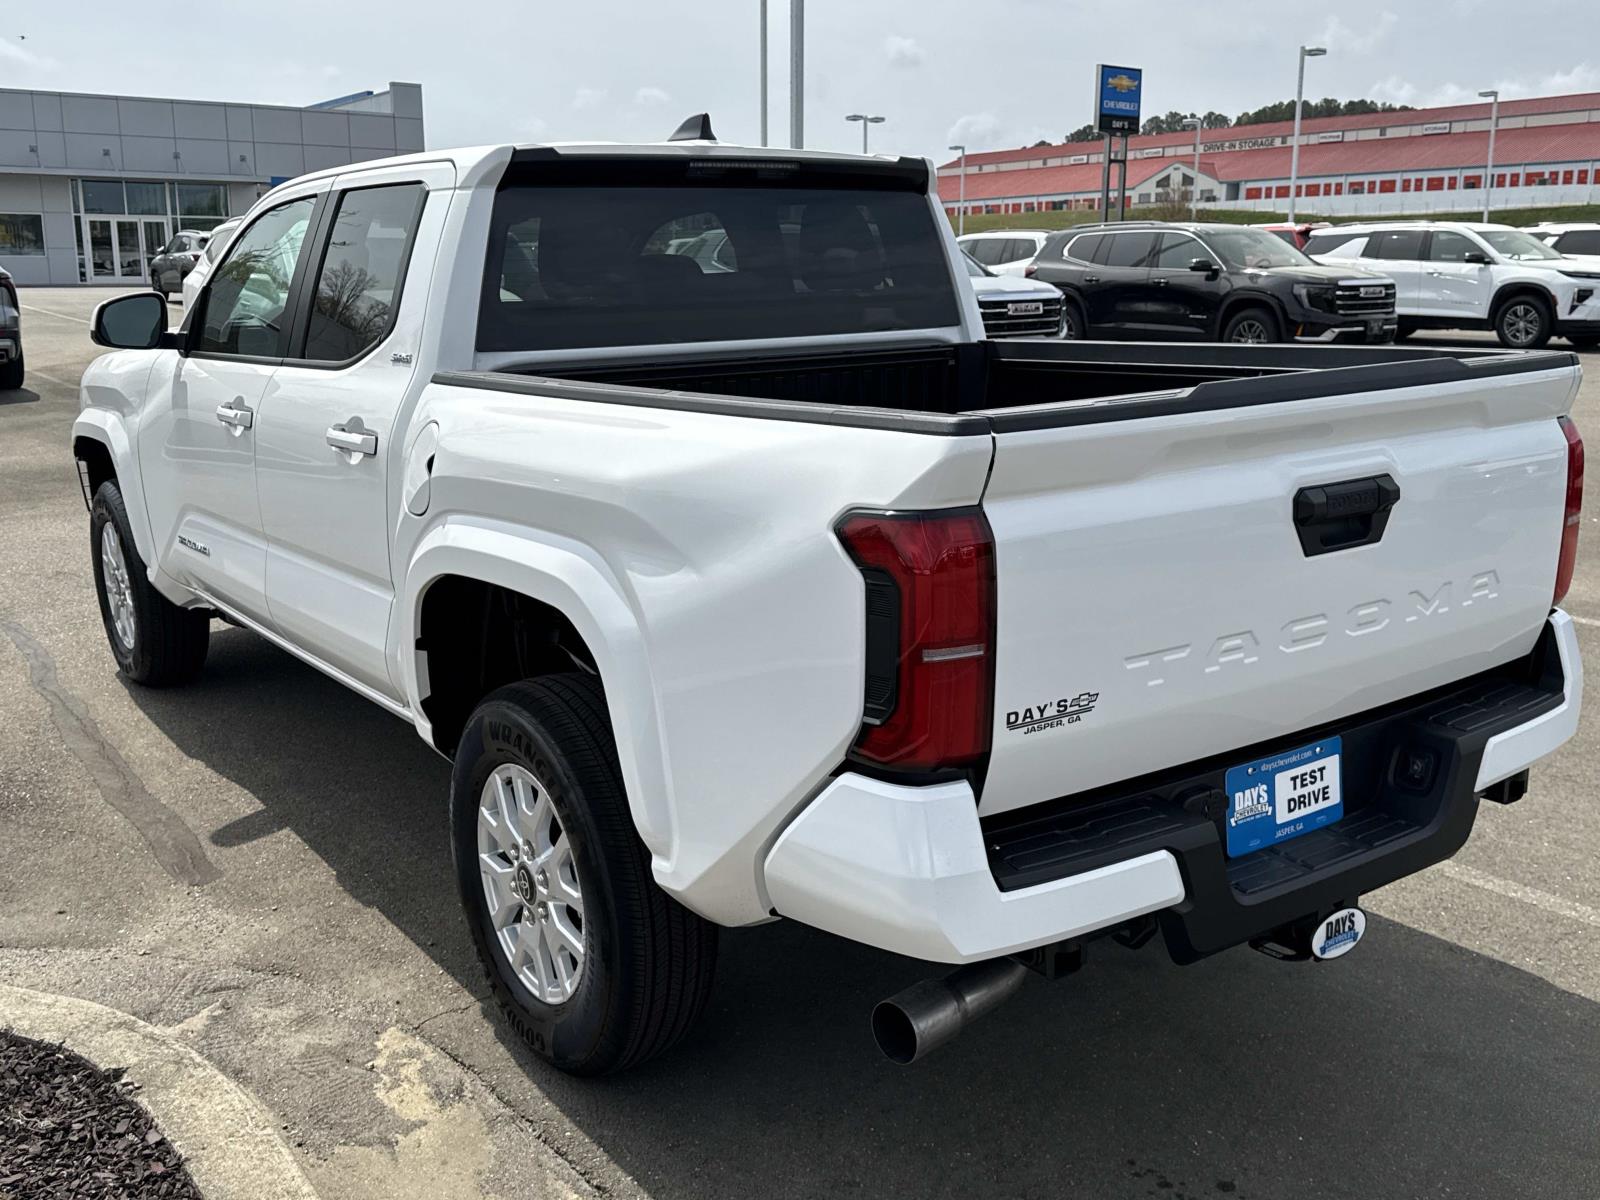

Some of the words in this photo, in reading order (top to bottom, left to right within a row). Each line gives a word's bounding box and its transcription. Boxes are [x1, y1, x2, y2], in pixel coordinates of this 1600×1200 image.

[1203, 142, 1237, 152] DRIVE-IN
[1238, 138, 1276, 150] STORAGE
[1124, 569, 1501, 687] TACOMA
[1006, 698, 1068, 726] DAY'S
[1024, 719, 1065, 735] JASPER,
[1068, 714, 1082, 724] GA
[1261, 751, 1312, 772] dayschevrolet.com
[1290, 766, 1326, 791] TEST
[1234, 782, 1268, 811] DAY'S
[1287, 785, 1330, 813] DRIVE
[1235, 803, 1268, 820] CHEVROLET
[1325, 911, 1355, 940] DAY'S
